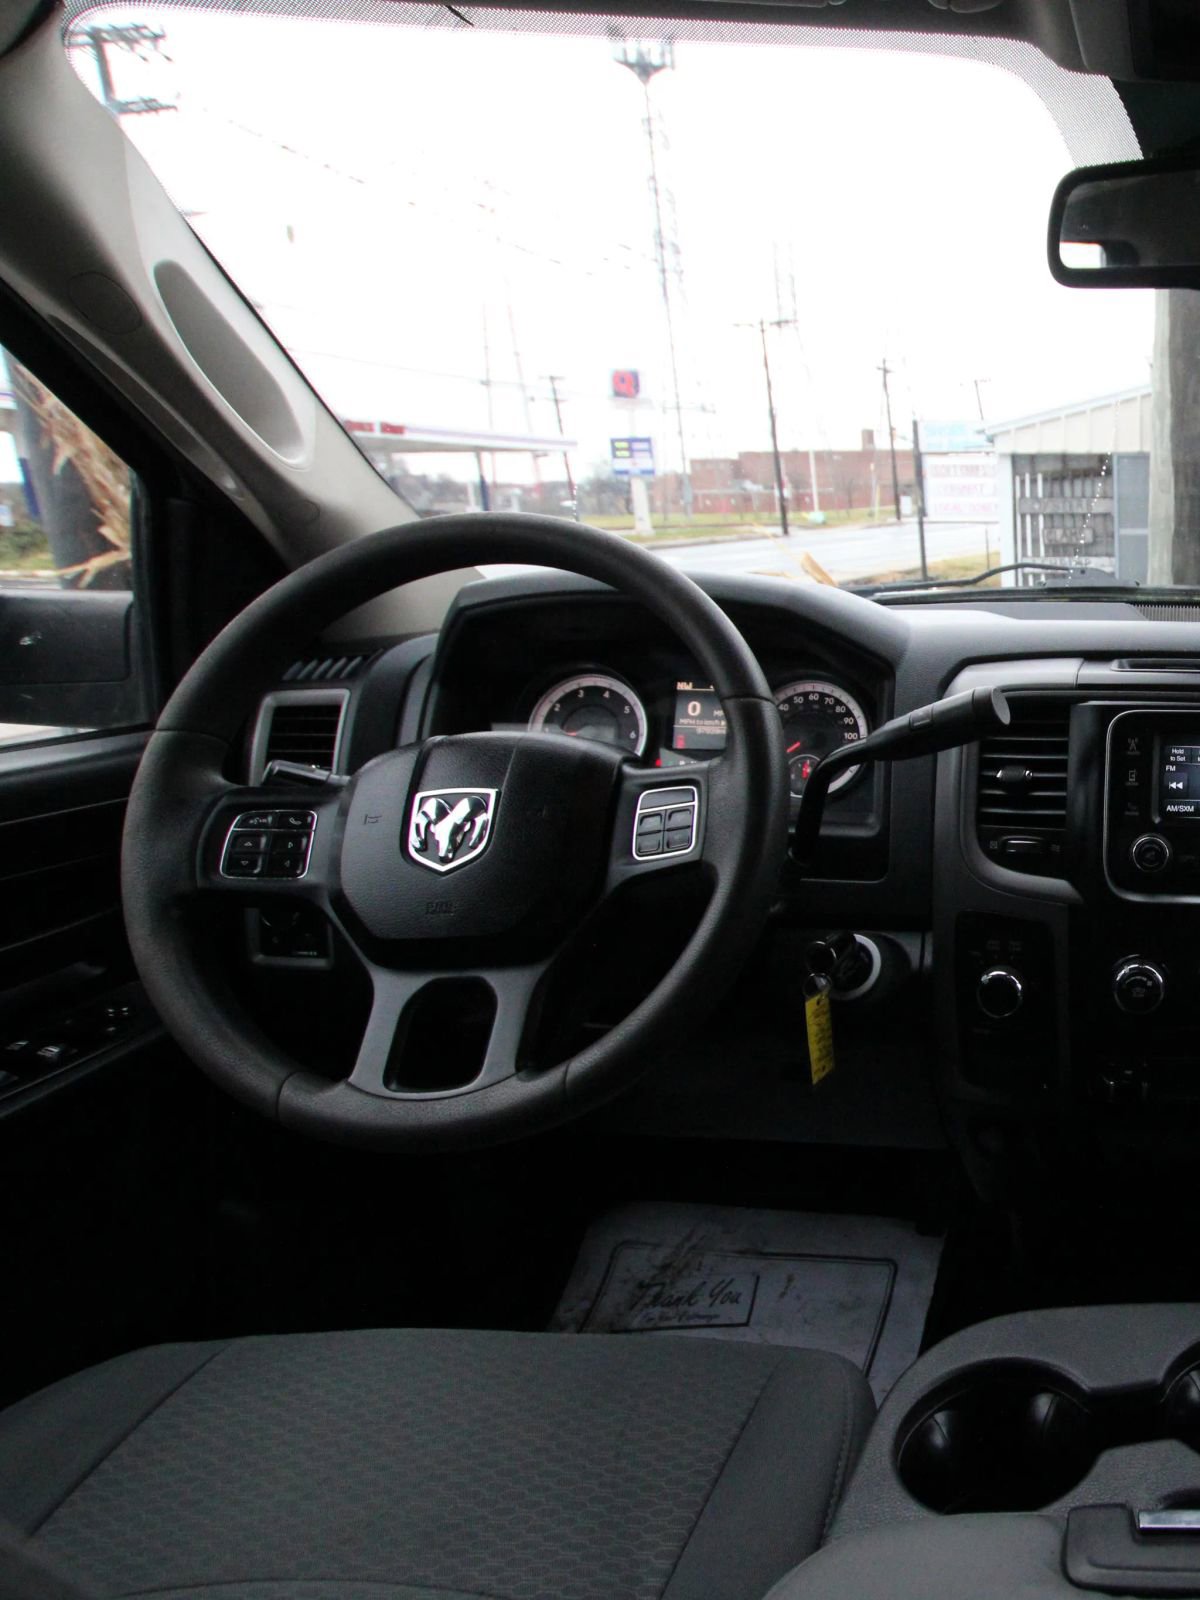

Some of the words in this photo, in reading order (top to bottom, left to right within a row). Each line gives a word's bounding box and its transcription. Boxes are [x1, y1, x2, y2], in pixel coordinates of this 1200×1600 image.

[577, 689, 585, 698] 3
[602, 690, 611, 698] 4
[808, 693, 820, 701] 60
[793, 696, 804, 704] 50
[824, 697, 835, 705] 70
[687, 700, 702, 717] 0
[778, 703, 790, 711] 40
[835, 705, 846, 713] 80
[843, 717, 854, 725] 90
[629, 730, 637, 739] 6
[843, 732, 858, 740] 100
[708, 1277, 743, 1308] You
